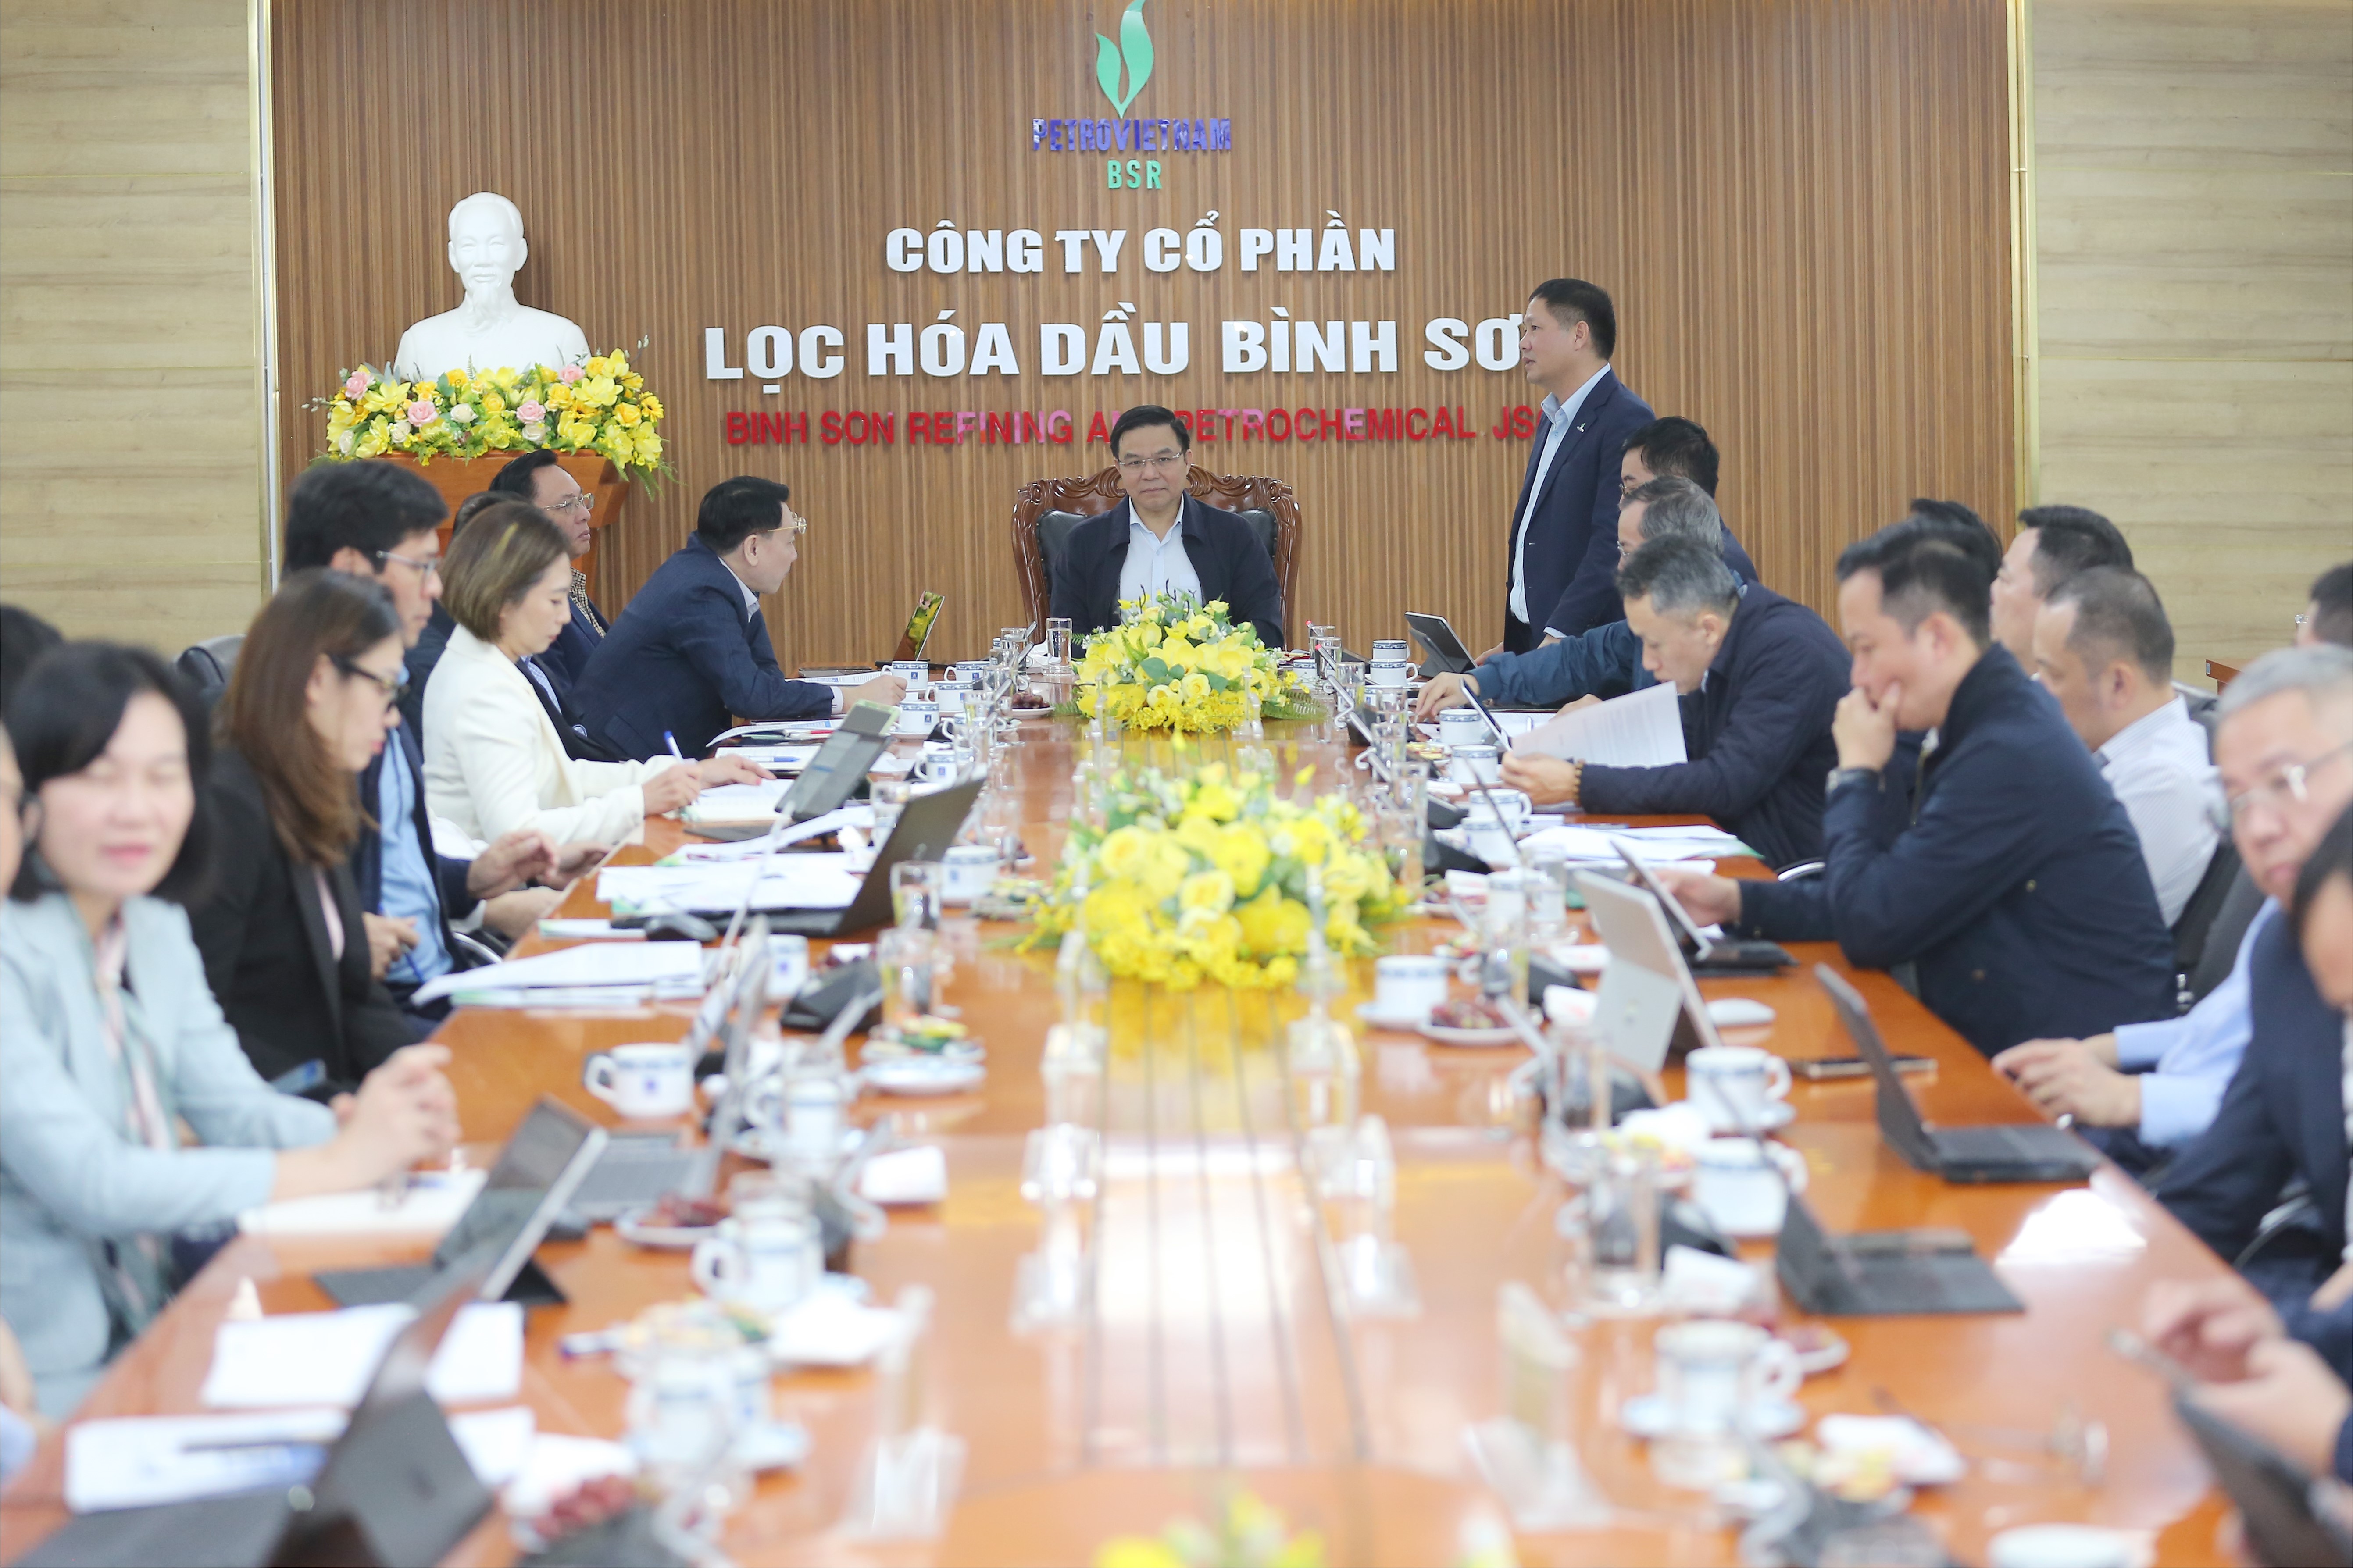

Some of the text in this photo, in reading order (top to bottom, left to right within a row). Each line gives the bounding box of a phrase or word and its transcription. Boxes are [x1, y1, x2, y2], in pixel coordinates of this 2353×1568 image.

[1032, 118, 1231, 151] PETROVIETNAM
[1107, 159, 1162, 189] BSR
[885, 219, 1127, 274] CÔNG TY
[1143, 210, 1396, 273] CỔ PHẦN
[705, 301, 1524, 395] LỌC HÓA DẦU BÌNH SƠ
[725, 410, 807, 445] BINH
[821, 410, 895, 445] SON
[908, 410, 1073, 445] REFINING
[1492, 405, 1542, 439] JS
